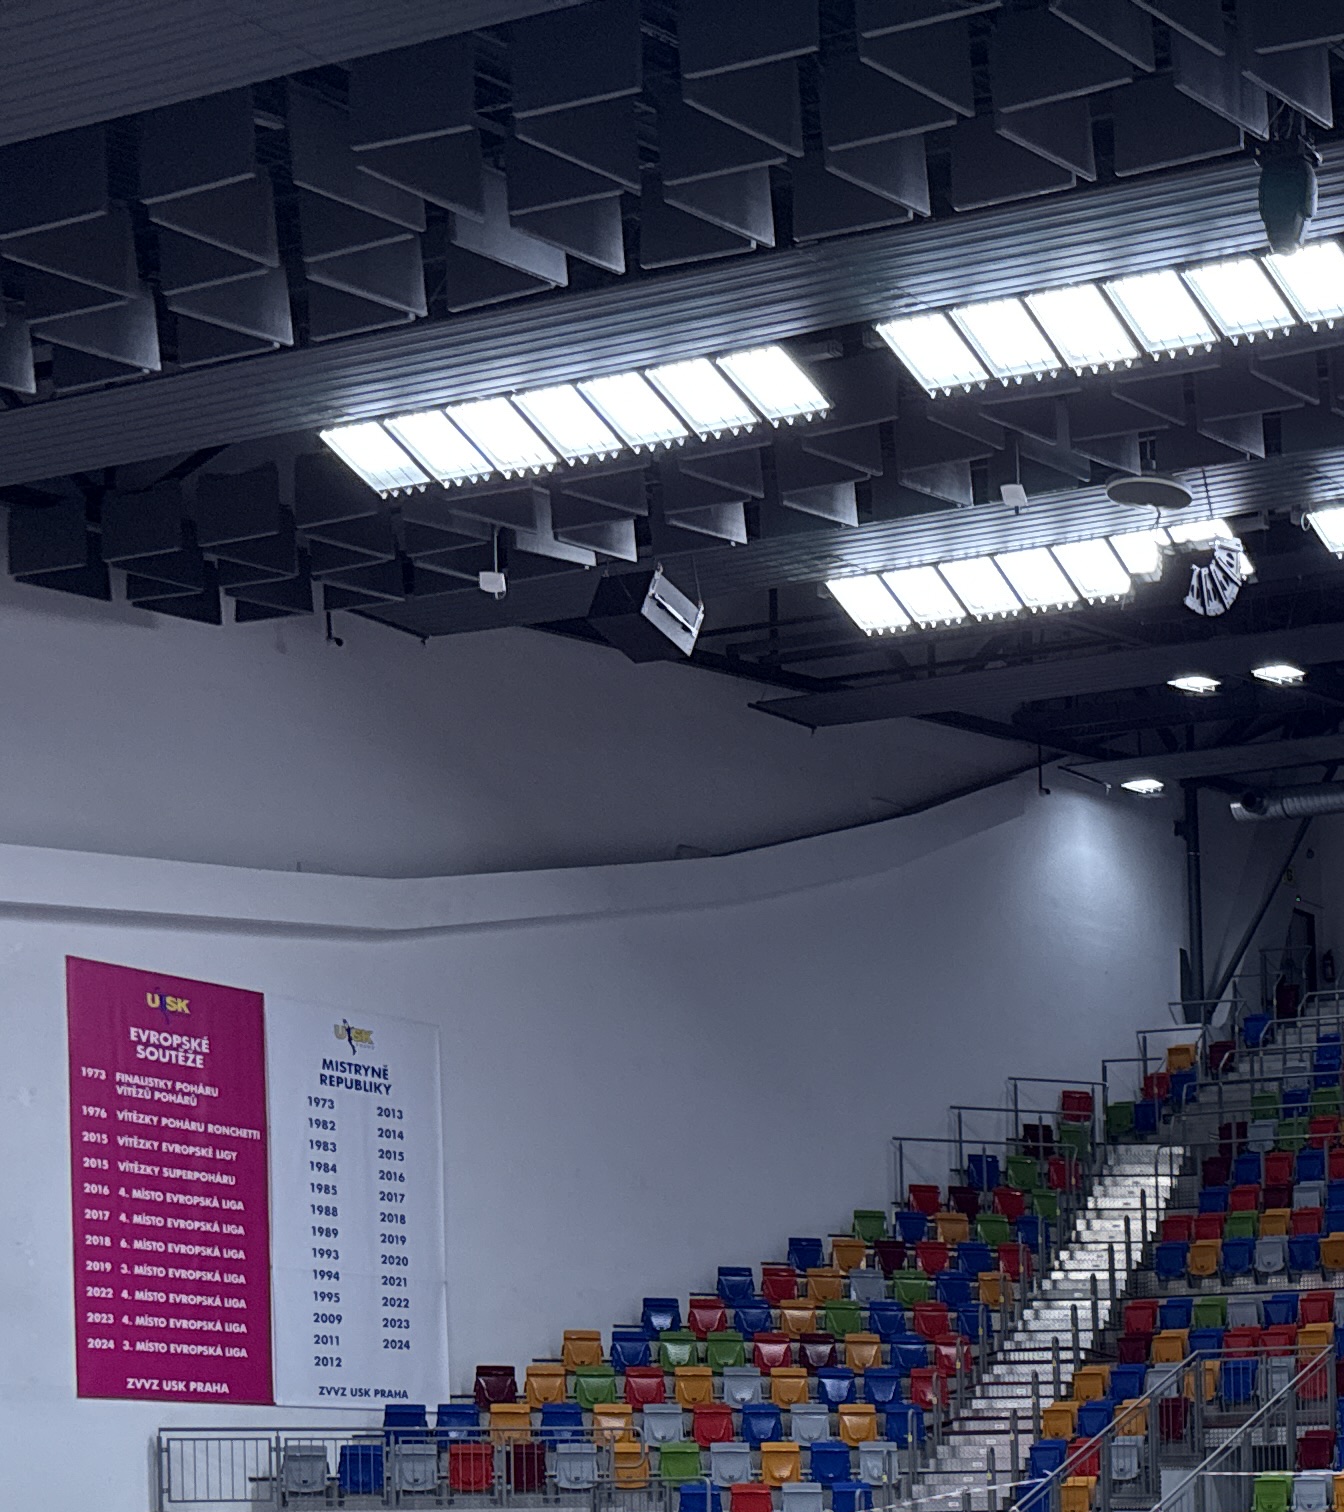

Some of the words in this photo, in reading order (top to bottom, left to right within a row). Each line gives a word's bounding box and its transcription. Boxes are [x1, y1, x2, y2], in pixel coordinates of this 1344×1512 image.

[130, 1026, 210, 1053] EVROPSKÉ
[136, 1045, 204, 1069] SOUTĚŽE
[322, 1058, 389, 1080] MISTRYNĚ
[81, 1067, 106, 1080] 1973
[116, 1072, 172, 1089] FINALISTKY
[176, 1082, 218, 1097] POHÁRU
[320, 1073, 392, 1095] REPUBLIKY
[116, 1085, 151, 1099] VÍTĚZŮ
[154, 1091, 197, 1106] POHÁRŮ
[308, 1096, 335, 1109] 1973
[377, 1107, 403, 1120] 2013
[82, 1106, 107, 1118] 1976
[117, 1109, 158, 1125] VÍTĚZKY
[161, 1117, 204, 1132] POHÁRU
[208, 1124, 260, 1140] RONCHETTI
[308, 1118, 336, 1131] 1982
[378, 1128, 404, 1140] 2014
[82, 1132, 108, 1144] 2015
[117, 1135, 158, 1150] VÍTĚZKY
[162, 1142, 213, 1158] EVROPSKÉ
[216, 1150, 238, 1160] LIGY
[309, 1139, 337, 1152] 1983
[378, 1149, 404, 1161] 2015
[83, 1158, 109, 1169] 2015
[118, 1160, 159, 1175] VÍTĚZKY
[163, 1168, 235, 1185] SUPERPOHÁRU
[310, 1161, 337, 1173] 1984
[379, 1170, 405, 1182] 2016
[310, 1183, 337, 1195] 1985
[84, 1183, 109, 1195] 2016
[118, 1188, 129, 1197] 4.
[132, 1188, 163, 1201] MÍSTO
[166, 1193, 219, 1207] EVROPSKÁ
[222, 1199, 244, 1210] LIGA
[379, 1191, 405, 1203] 2017
[311, 1204, 338, 1217] 1988
[84, 1209, 109, 1220] 2017
[119, 1213, 130, 1222] 4.
[133, 1213, 164, 1226] MÍSTO
[167, 1218, 219, 1232] EVROPSKÁ
[223, 1224, 245, 1235] LIGA
[380, 1212, 406, 1224] 2018
[312, 1226, 338, 1238] 1989
[380, 1234, 406, 1245] 2019
[85, 1235, 111, 1246] 2018
[120, 1239, 130, 1248] 6.
[133, 1238, 165, 1252] MÍSTO
[168, 1243, 220, 1258] EVROPSKÁ
[223, 1248, 245, 1259] LIGA
[312, 1248, 339, 1260] 1993
[381, 1254, 408, 1266] 2020
[86, 1261, 112, 1272] 2019
[120, 1264, 131, 1274] 3.
[134, 1263, 166, 1277] MÍSTO
[168, 1268, 221, 1282] EVROPSKÁ
[224, 1273, 246, 1284] LIGA
[313, 1269, 340, 1281] 1994
[381, 1276, 407, 1287] 2021
[86, 1287, 113, 1298] 2022
[121, 1290, 132, 1299] 4.
[135, 1289, 166, 1302] MÍSTO
[169, 1293, 222, 1307] EVROPSKÁ
[224, 1298, 247, 1309] LIGA
[313, 1291, 340, 1303] 1995
[382, 1297, 410, 1308] 2022
[87, 1312, 114, 1323] 2023
[122, 1315, 132, 1325] 4.
[135, 1314, 167, 1327] MÍSTO
[169, 1318, 222, 1331] EVROPSKÁ
[225, 1322, 247, 1333] LIGA
[313, 1313, 342, 1324] 2009
[382, 1318, 410, 1329] 2023
[314, 1334, 340, 1346] 2011
[383, 1339, 410, 1350] 2024
[87, 1338, 115, 1349] 2024
[123, 1341, 133, 1350] 3.
[136, 1340, 167, 1352] MÍSTO
[170, 1342, 223, 1356] EVROPSKÁ
[225, 1347, 248, 1358] LIGA
[314, 1356, 342, 1367] 2012
[127, 1378, 160, 1390] ZVVZ
[163, 1380, 186, 1391] USK
[190, 1382, 229, 1393] PRAHA
[319, 1386, 347, 1397] ZVVZ
[350, 1388, 371, 1398] USK
[374, 1389, 408, 1399] PRAHA
